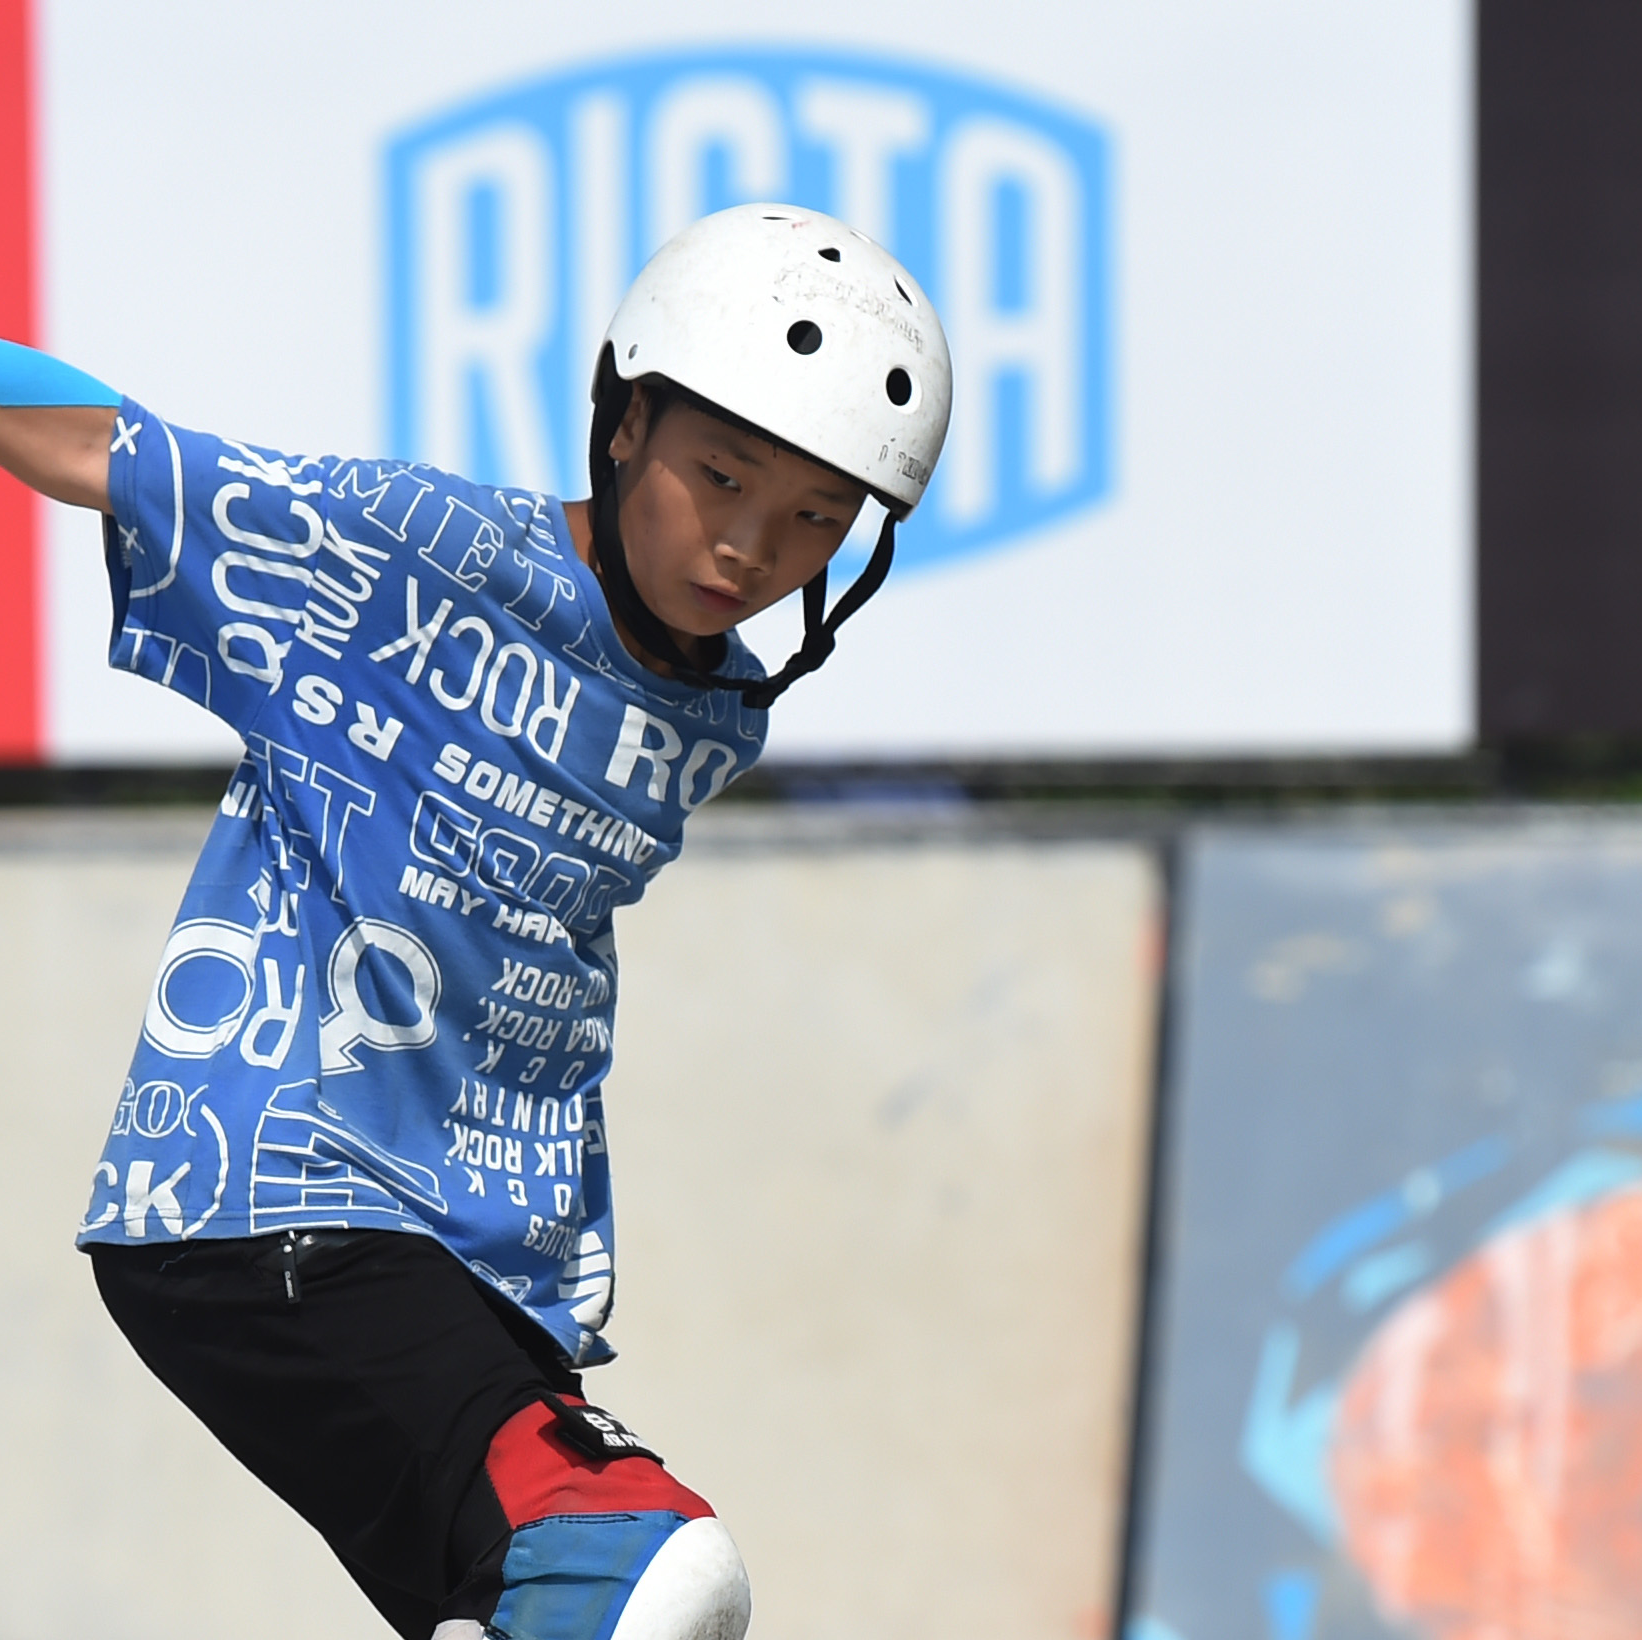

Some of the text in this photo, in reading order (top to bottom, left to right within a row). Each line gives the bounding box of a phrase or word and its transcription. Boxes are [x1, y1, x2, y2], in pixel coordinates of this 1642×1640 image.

[368, 574, 580, 764] ROCK
[398, 865, 486, 916] MAY
[474, 996, 562, 1050] ROCK,
[442, 1118, 523, 1174] ROCK,
